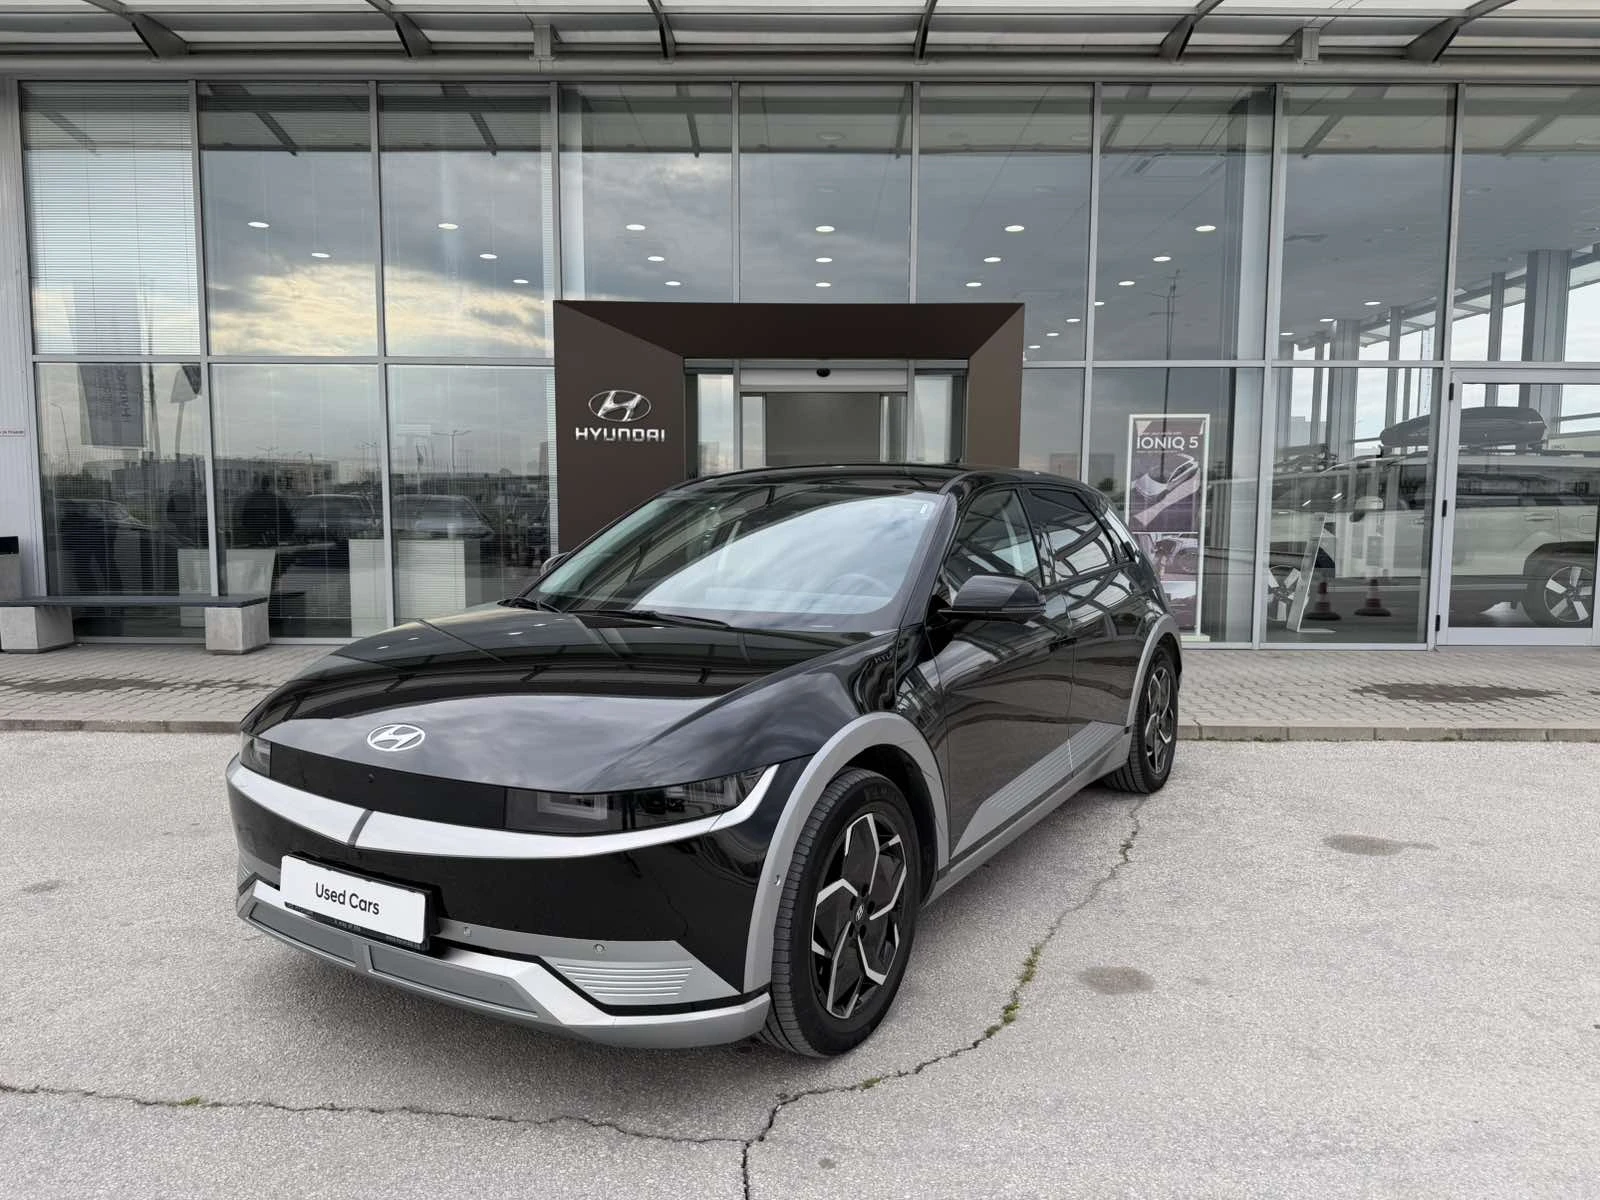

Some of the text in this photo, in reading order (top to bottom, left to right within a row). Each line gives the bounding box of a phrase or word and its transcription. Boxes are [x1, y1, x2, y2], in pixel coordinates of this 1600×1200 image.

[575, 427, 665, 442] HYUNDAI
[1136, 436, 1199, 451] IONIQ 5
[315, 882, 380, 915] Used Cars
